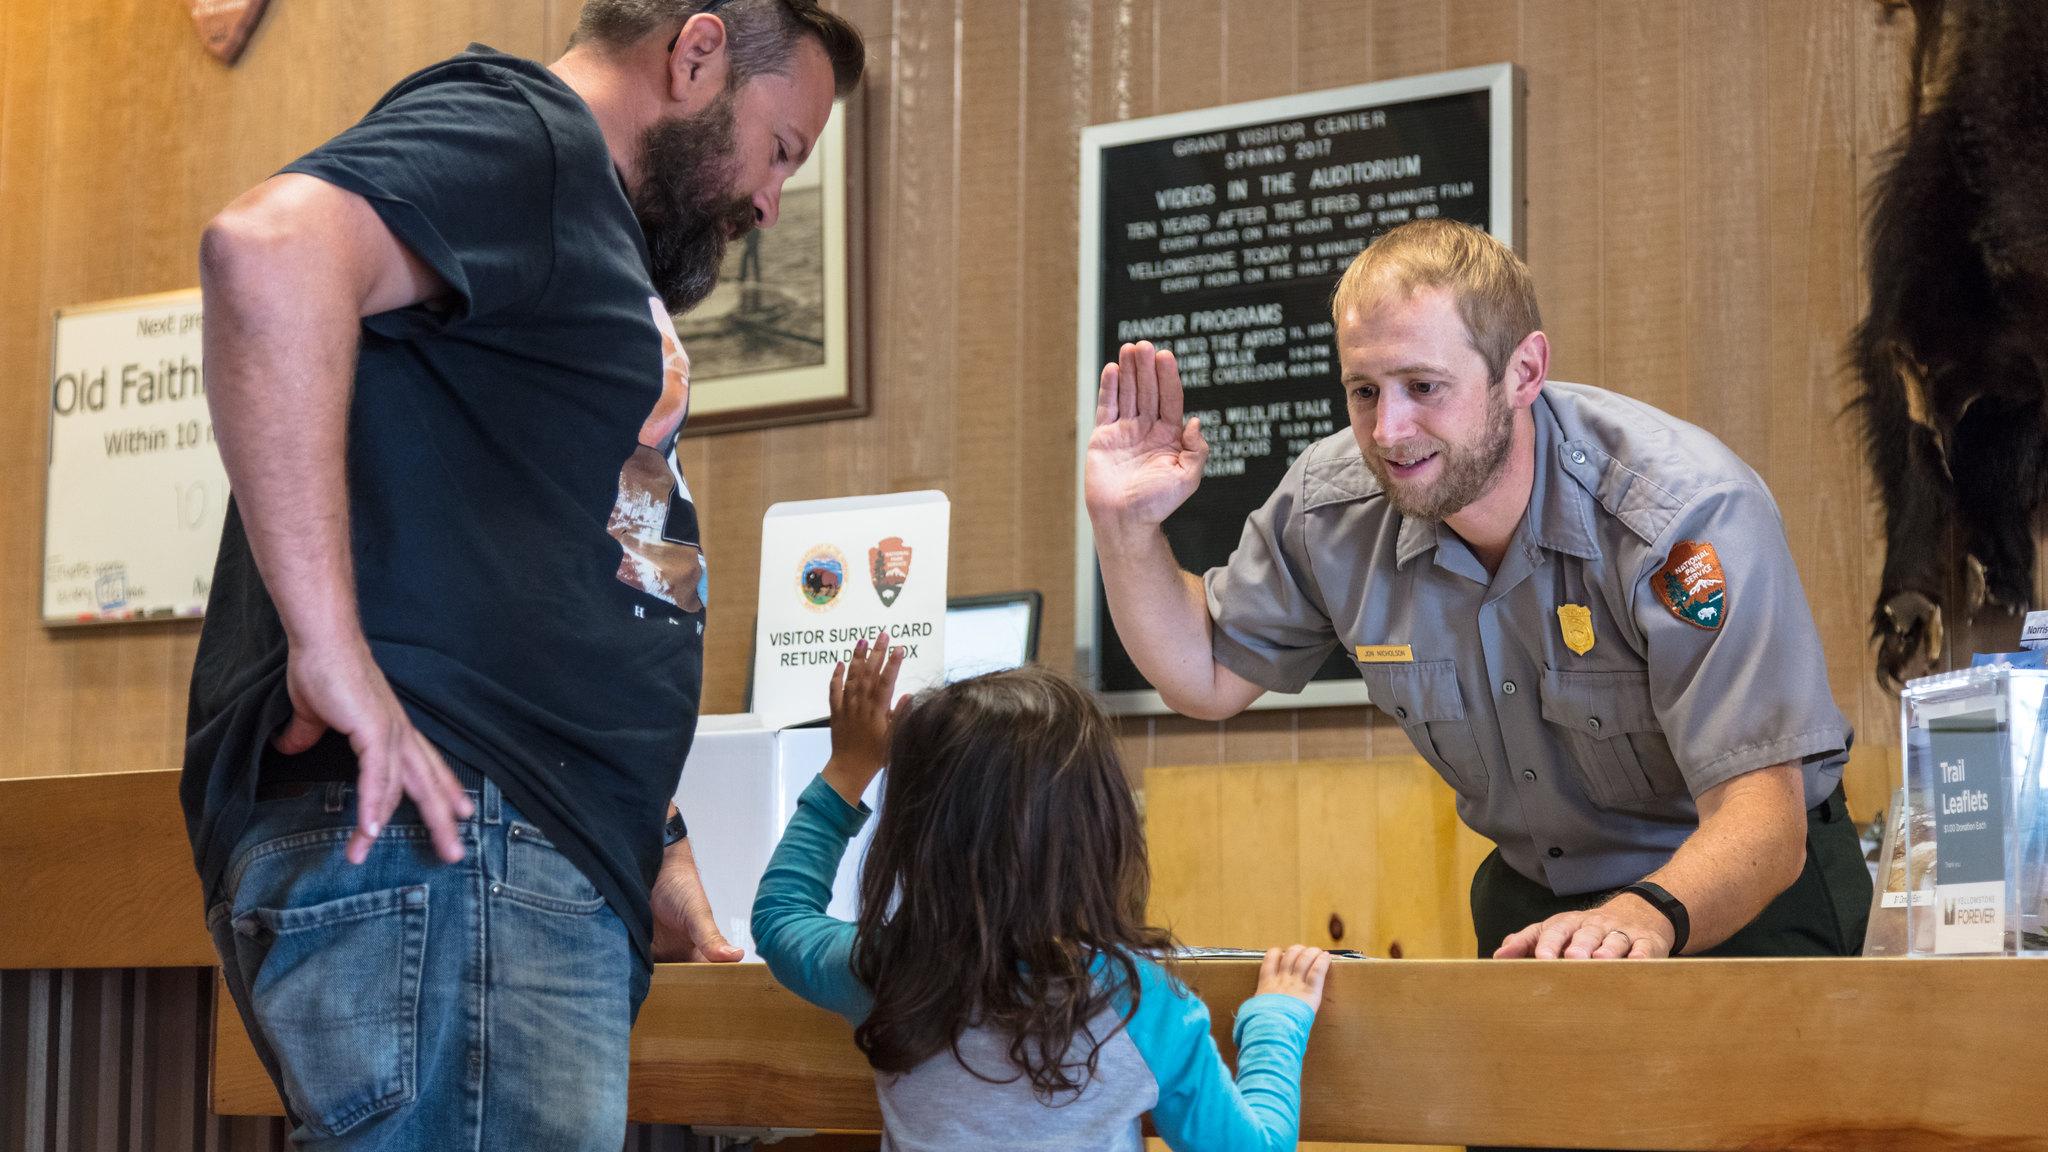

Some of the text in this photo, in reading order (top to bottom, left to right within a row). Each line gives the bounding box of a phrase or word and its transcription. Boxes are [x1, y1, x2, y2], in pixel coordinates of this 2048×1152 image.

[1172, 110, 1386, 158] GRANT VISITOR CENTER
[1224, 138, 1332, 170] SPRING 2017
[1155, 154, 1421, 211] VIDEOS IN THE AUDITORIUM
[1161, 213, 1211, 235] YEARS
[1217, 205, 1267, 228] AFTER
[1272, 199, 1306, 221] THE
[1311, 193, 1361, 215] FIRES
[1387, 185, 1437, 206] MINUTE
[1439, 181, 1474, 199] FILM
[1202, 229, 1239, 247] HOUR
[1242, 226, 1263, 243] ON
[1266, 222, 1292, 238] THE
[1294, 216, 1333, 235] HOUR
[1127, 250, 1238, 281] YELLOWSTONE
[1241, 243, 1293, 267] TODAY
[1203, 270, 1241, 288] HOUR
[1243, 267, 1265, 284] ON
[1268, 263, 1295, 280] THE
[137, 314, 176, 337] Next
[1118, 303, 1283, 341] RANGER PROGRAMS
[54, 354, 206, 416] Old Faith
[1180, 368, 1211, 388] AKE
[1225, 401, 1291, 424] WILDLIFE
[1294, 398, 1332, 418] TALK
[104, 425, 167, 458] Within
[175, 420, 199, 448] 10
[1236, 423, 1272, 441] TALK
[1674, 550, 1710, 574] NATIONAL
[1684, 563, 1713, 585] SERVICE
[1685, 561, 1705, 576] PARK
[770, 622, 933, 647] VISITOR SURVEY CARD
[780, 650, 839, 666] RETURN
[1940, 759, 1966, 784] Trail
[1942, 789, 1989, 815] Leaflets
[1958, 907, 1996, 925] FOREVER
